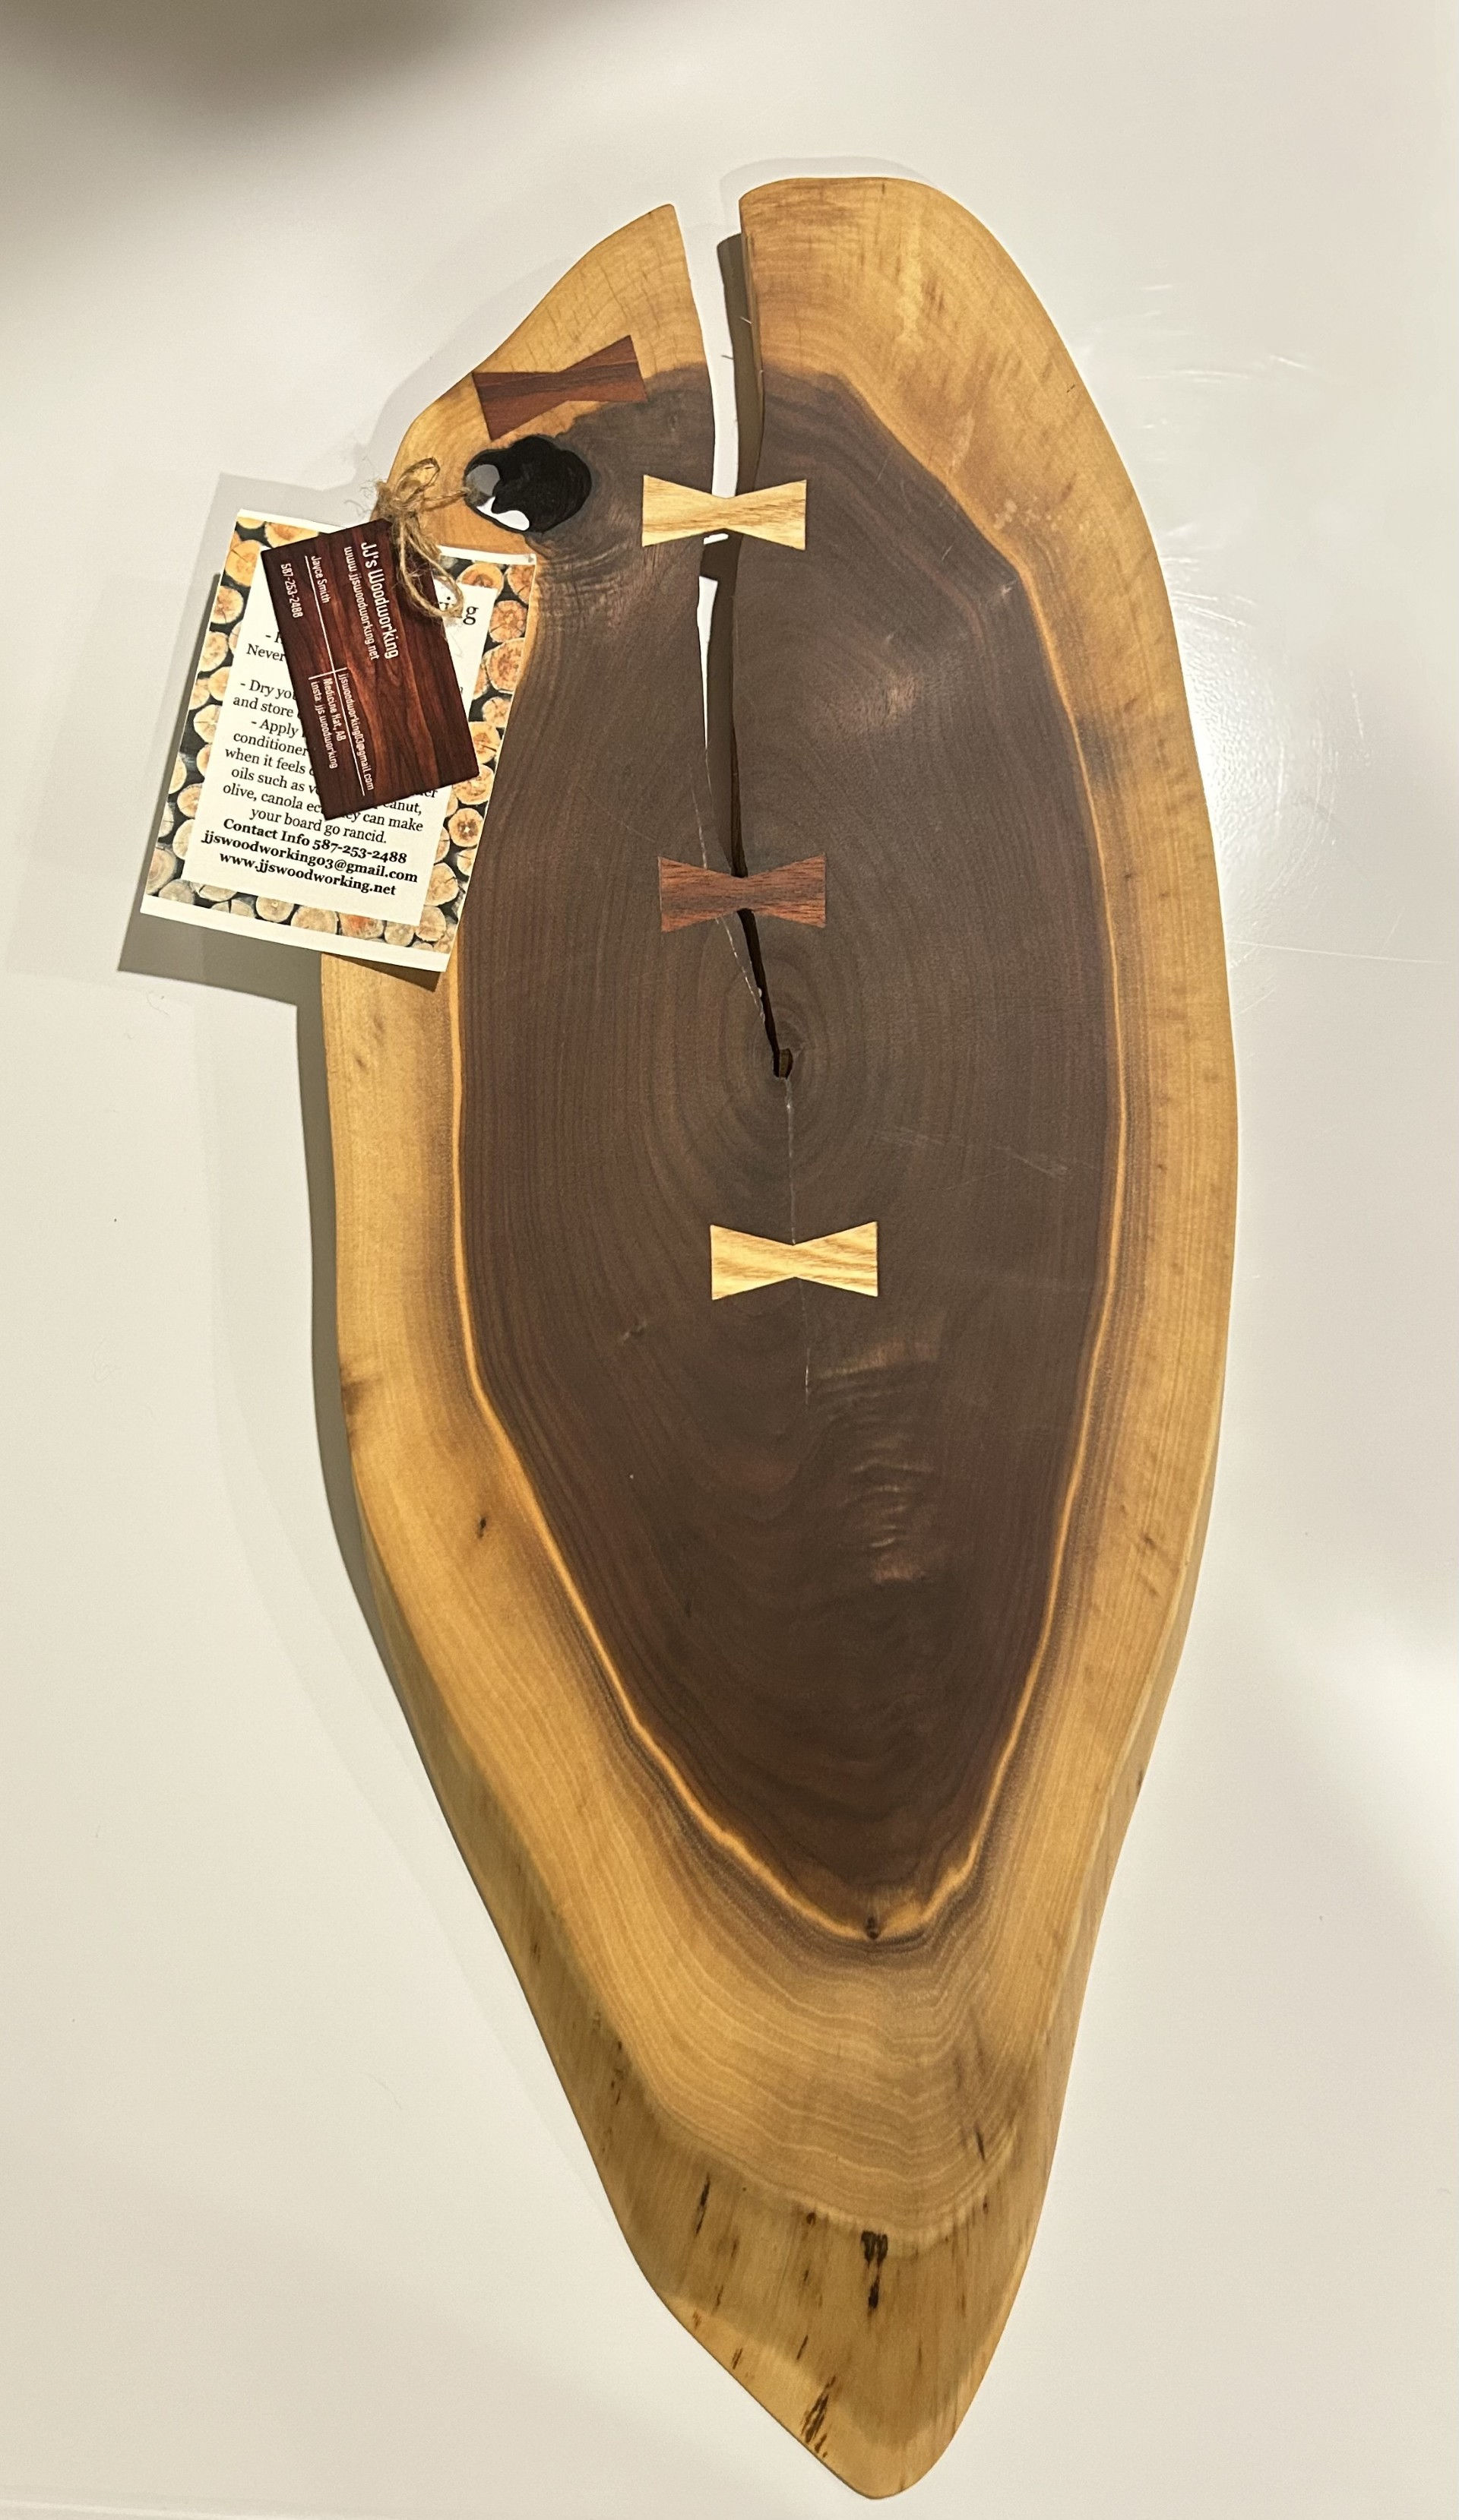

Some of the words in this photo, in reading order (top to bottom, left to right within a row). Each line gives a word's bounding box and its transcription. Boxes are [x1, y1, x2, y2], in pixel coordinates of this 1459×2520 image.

[360, 542, 379, 569] JJ's
[280, 563, 303, 618] 587-253-2488
[311, 555, 323, 578] Jayce
[317, 578, 331, 603] Smith
[344, 546, 380, 660] www.jjswoodworking.net
[368, 568, 399, 659] Woodworking
[246, 643, 286, 662] Never
[233, 697, 258, 710] and
[261, 702, 293, 717] store
[249, 680, 274, 697] Dry
[275, 688, 296, 700] yo
[323, 678, 337, 714] Medicine
[259, 719, 299, 738] Apply
[331, 713, 342, 731] Hat,
[335, 730, 347, 741] AB
[338, 672, 374, 791] jjswoodworking03@gmail.com
[225, 748, 259, 764] when
[264, 754, 273, 767] it
[276, 757, 305, 774] feels
[233, 733, 308, 756] conditioner
[223, 783, 257, 802] olive,
[261, 793, 302, 810] canola
[363, 814, 385, 825] can
[388, 817, 423, 831] make
[232, 767, 255, 781] oils
[258, 774, 287, 788] such
[290, 782, 305, 792] as
[382, 801, 422, 815] eanut,
[223, 819, 278, 839] Contact
[280, 830, 310, 846] Info
[312, 839, 407, 863] 587-253-2488
[249, 808, 281, 823] your
[284, 812, 322, 831] board
[324, 824, 340, 836] go
[343, 827, 386, 843] rancid.
[201, 830, 418, 883] jjswoodworking03@gmail.com
[220, 853, 396, 895] www.jjswoodworking.net
